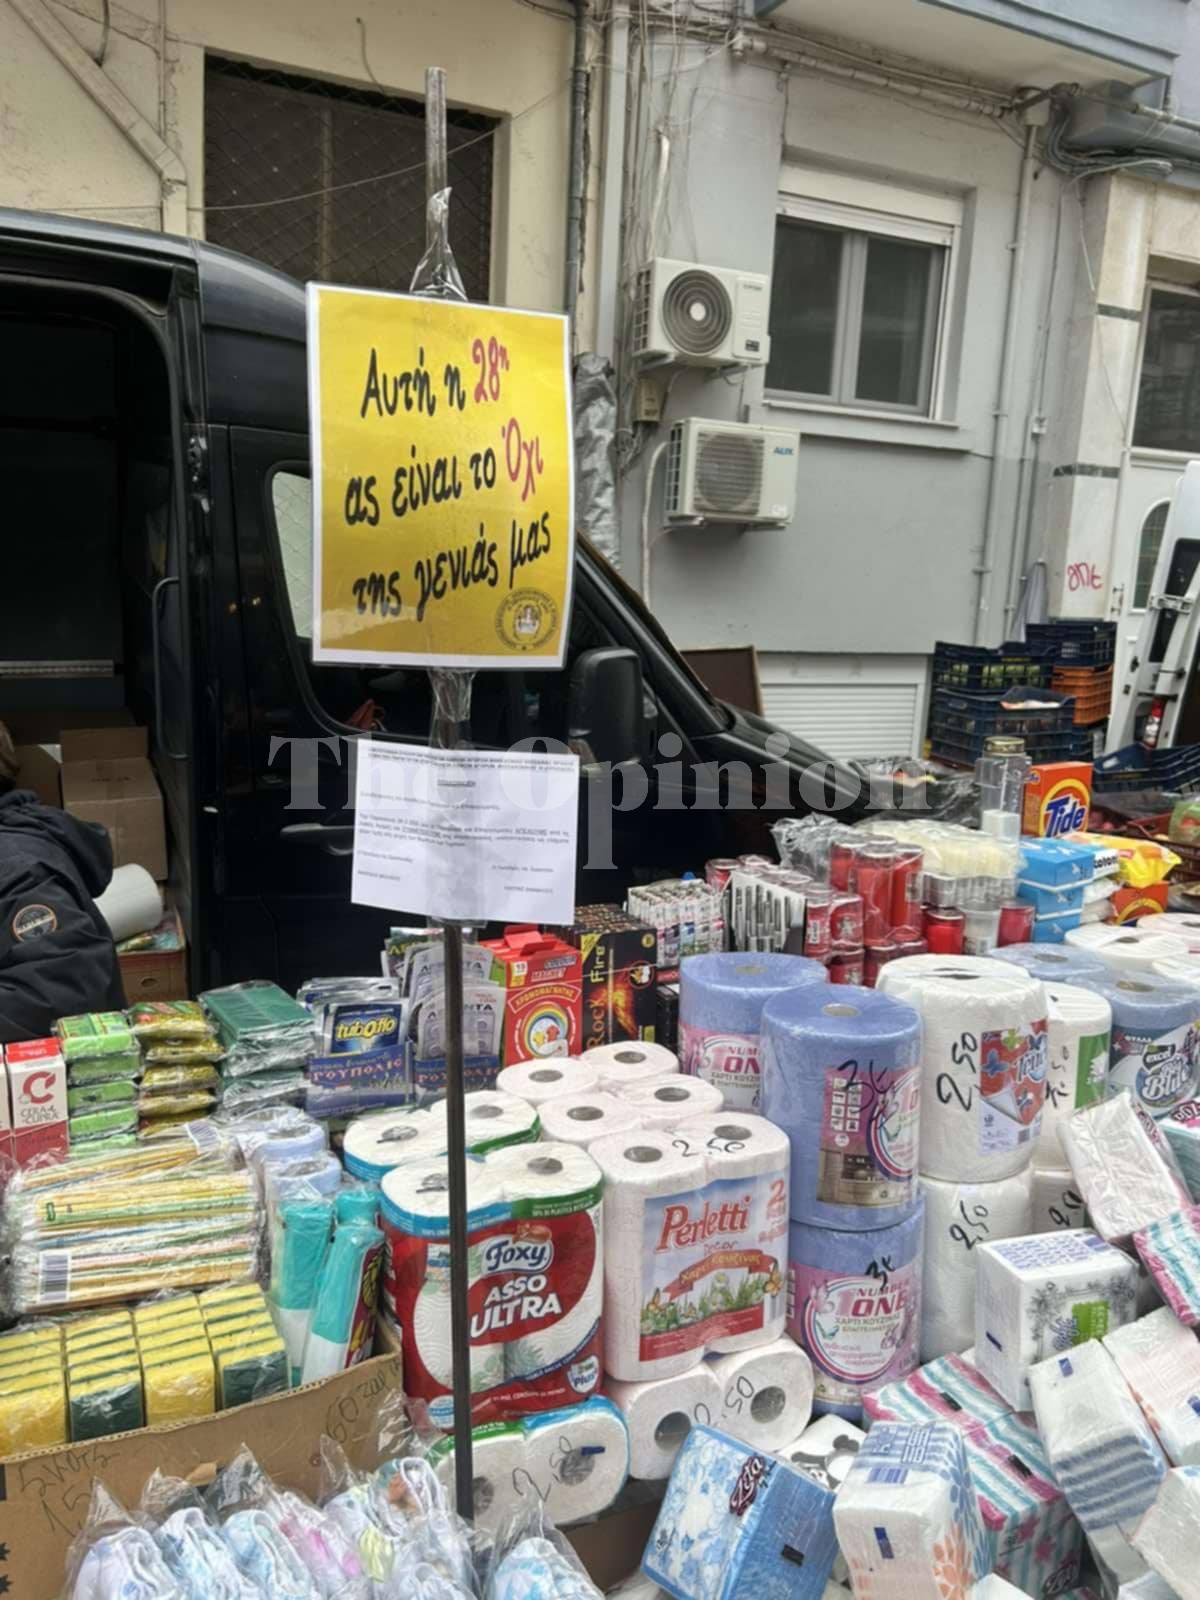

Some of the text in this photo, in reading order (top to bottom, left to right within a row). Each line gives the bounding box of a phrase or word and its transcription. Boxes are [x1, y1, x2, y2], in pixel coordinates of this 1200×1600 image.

[360, 346, 436, 419] Αυτή
[443, 364, 467, 412] η
[344, 417, 544, 526] ας είναι το Όχι
[352, 571, 402, 617] της
[414, 522, 499, 622] γενιάς
[509, 511, 551, 589] μας
[1045, 796, 1087, 838] Tide
[654, 1195, 752, 1252] Perletti
[485, 1237, 548, 1272] Foxy
[483, 1273, 548, 1308] ASSO
[851, 1289, 908, 1318] ONE
[469, 1292, 563, 1339] ULTRA
